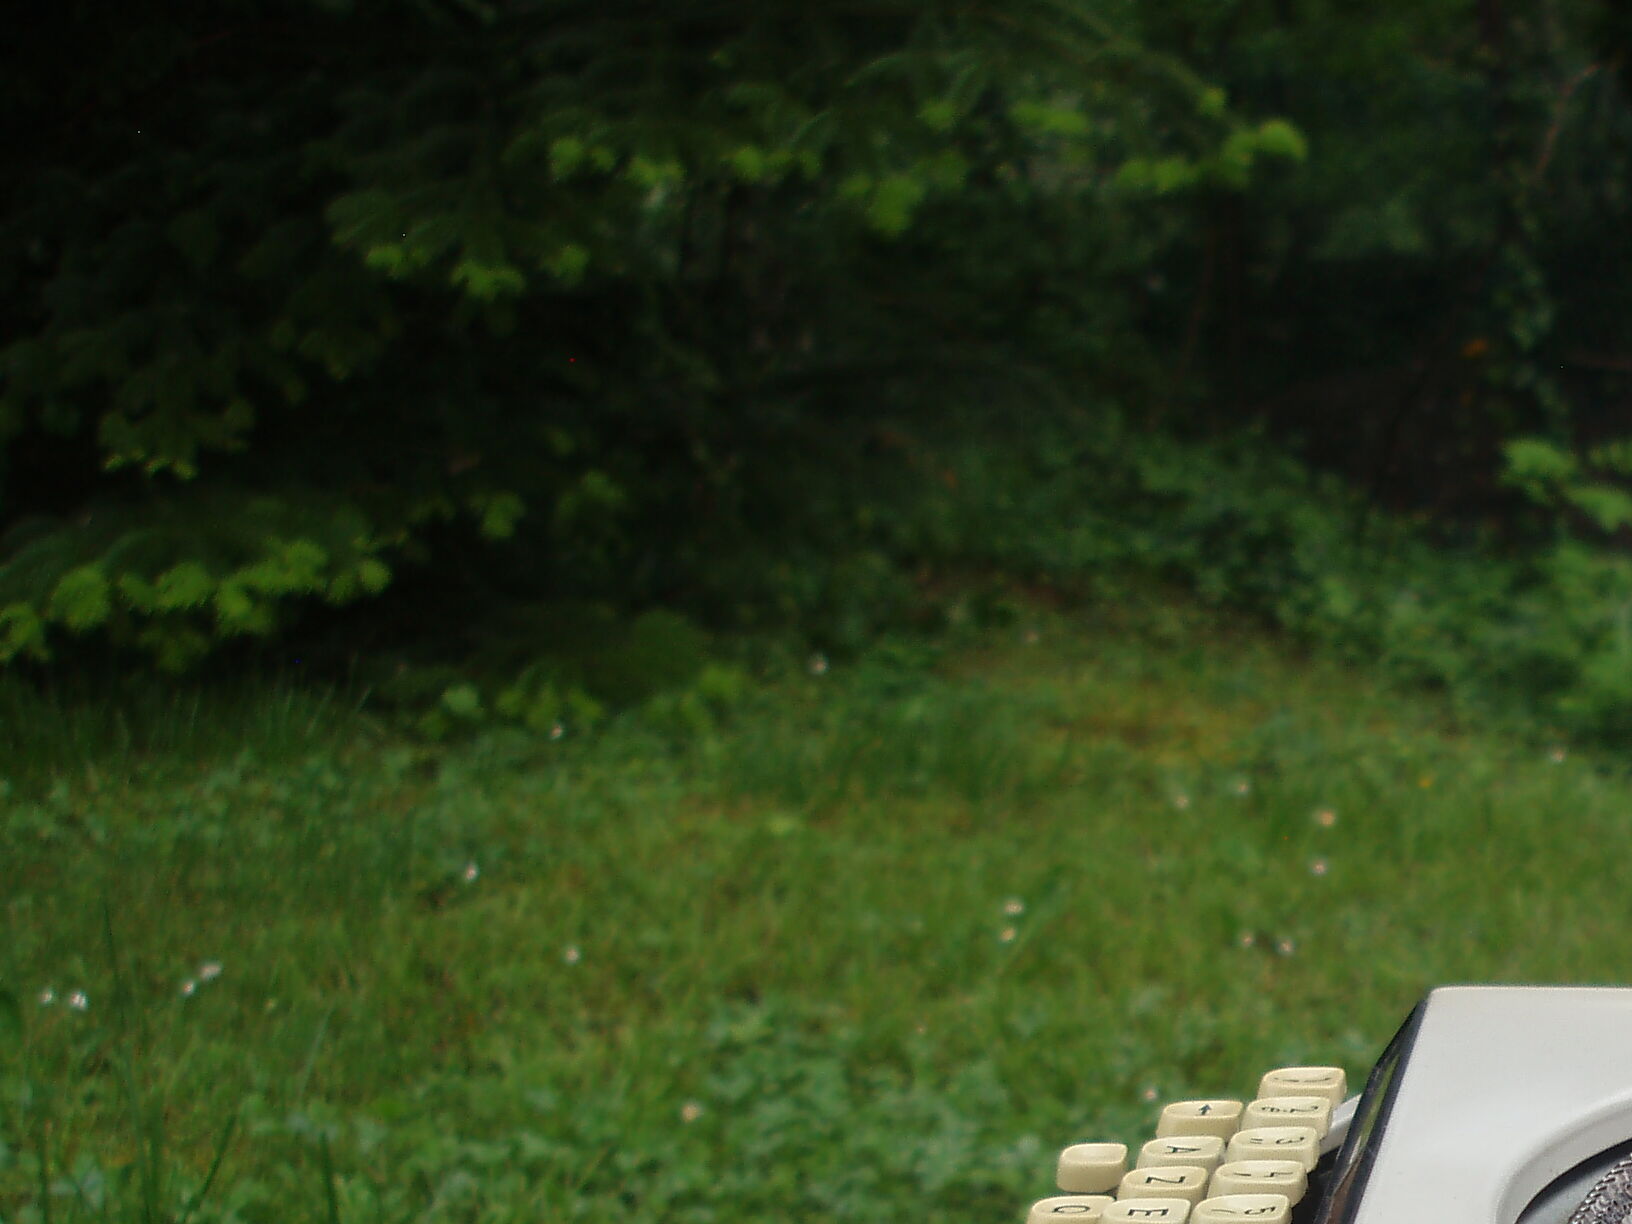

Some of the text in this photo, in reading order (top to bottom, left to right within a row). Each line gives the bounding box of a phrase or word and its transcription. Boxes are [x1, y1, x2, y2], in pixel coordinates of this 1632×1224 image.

[1275, 1136, 1305, 1145] 3
[1165, 1145, 1201, 1154] A
[1145, 1175, 1186, 1184] Z
[1127, 1208, 1169, 1217] E
[1244, 1206, 1276, 1215] 5
